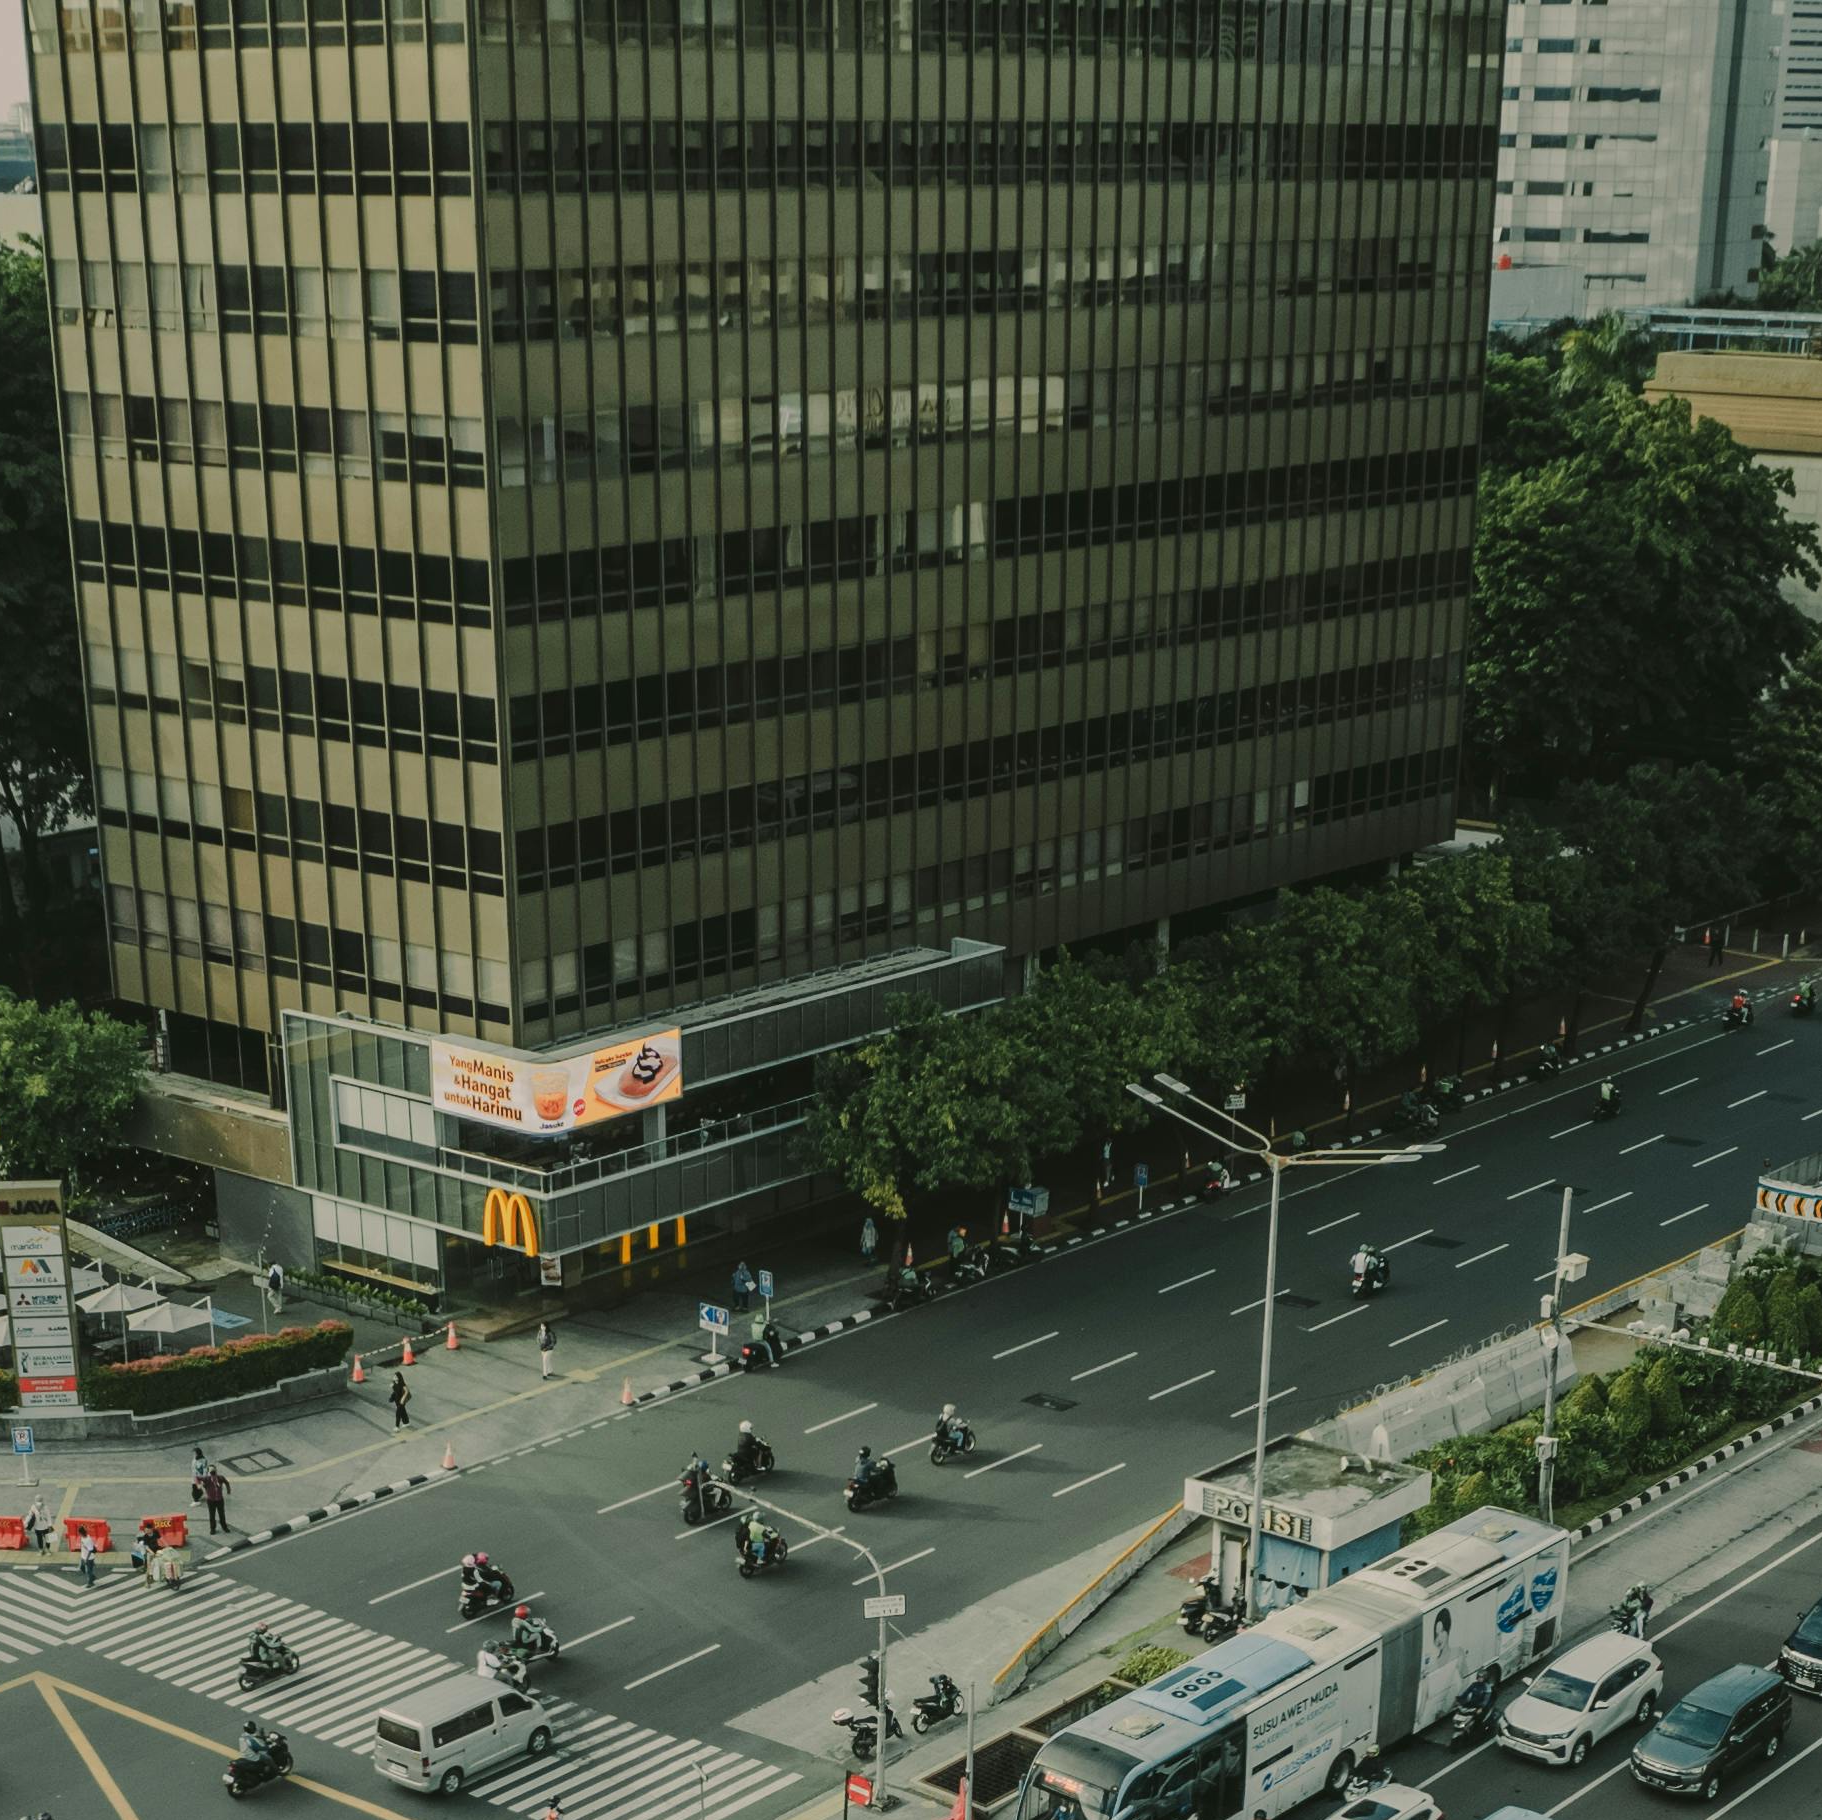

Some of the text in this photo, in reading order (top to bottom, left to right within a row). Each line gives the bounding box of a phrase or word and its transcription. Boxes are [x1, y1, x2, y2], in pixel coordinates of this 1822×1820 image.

[11, 1199, 60, 1215] JAYA
[1252, 1681, 1340, 1740] SUSU AWET MUDA
